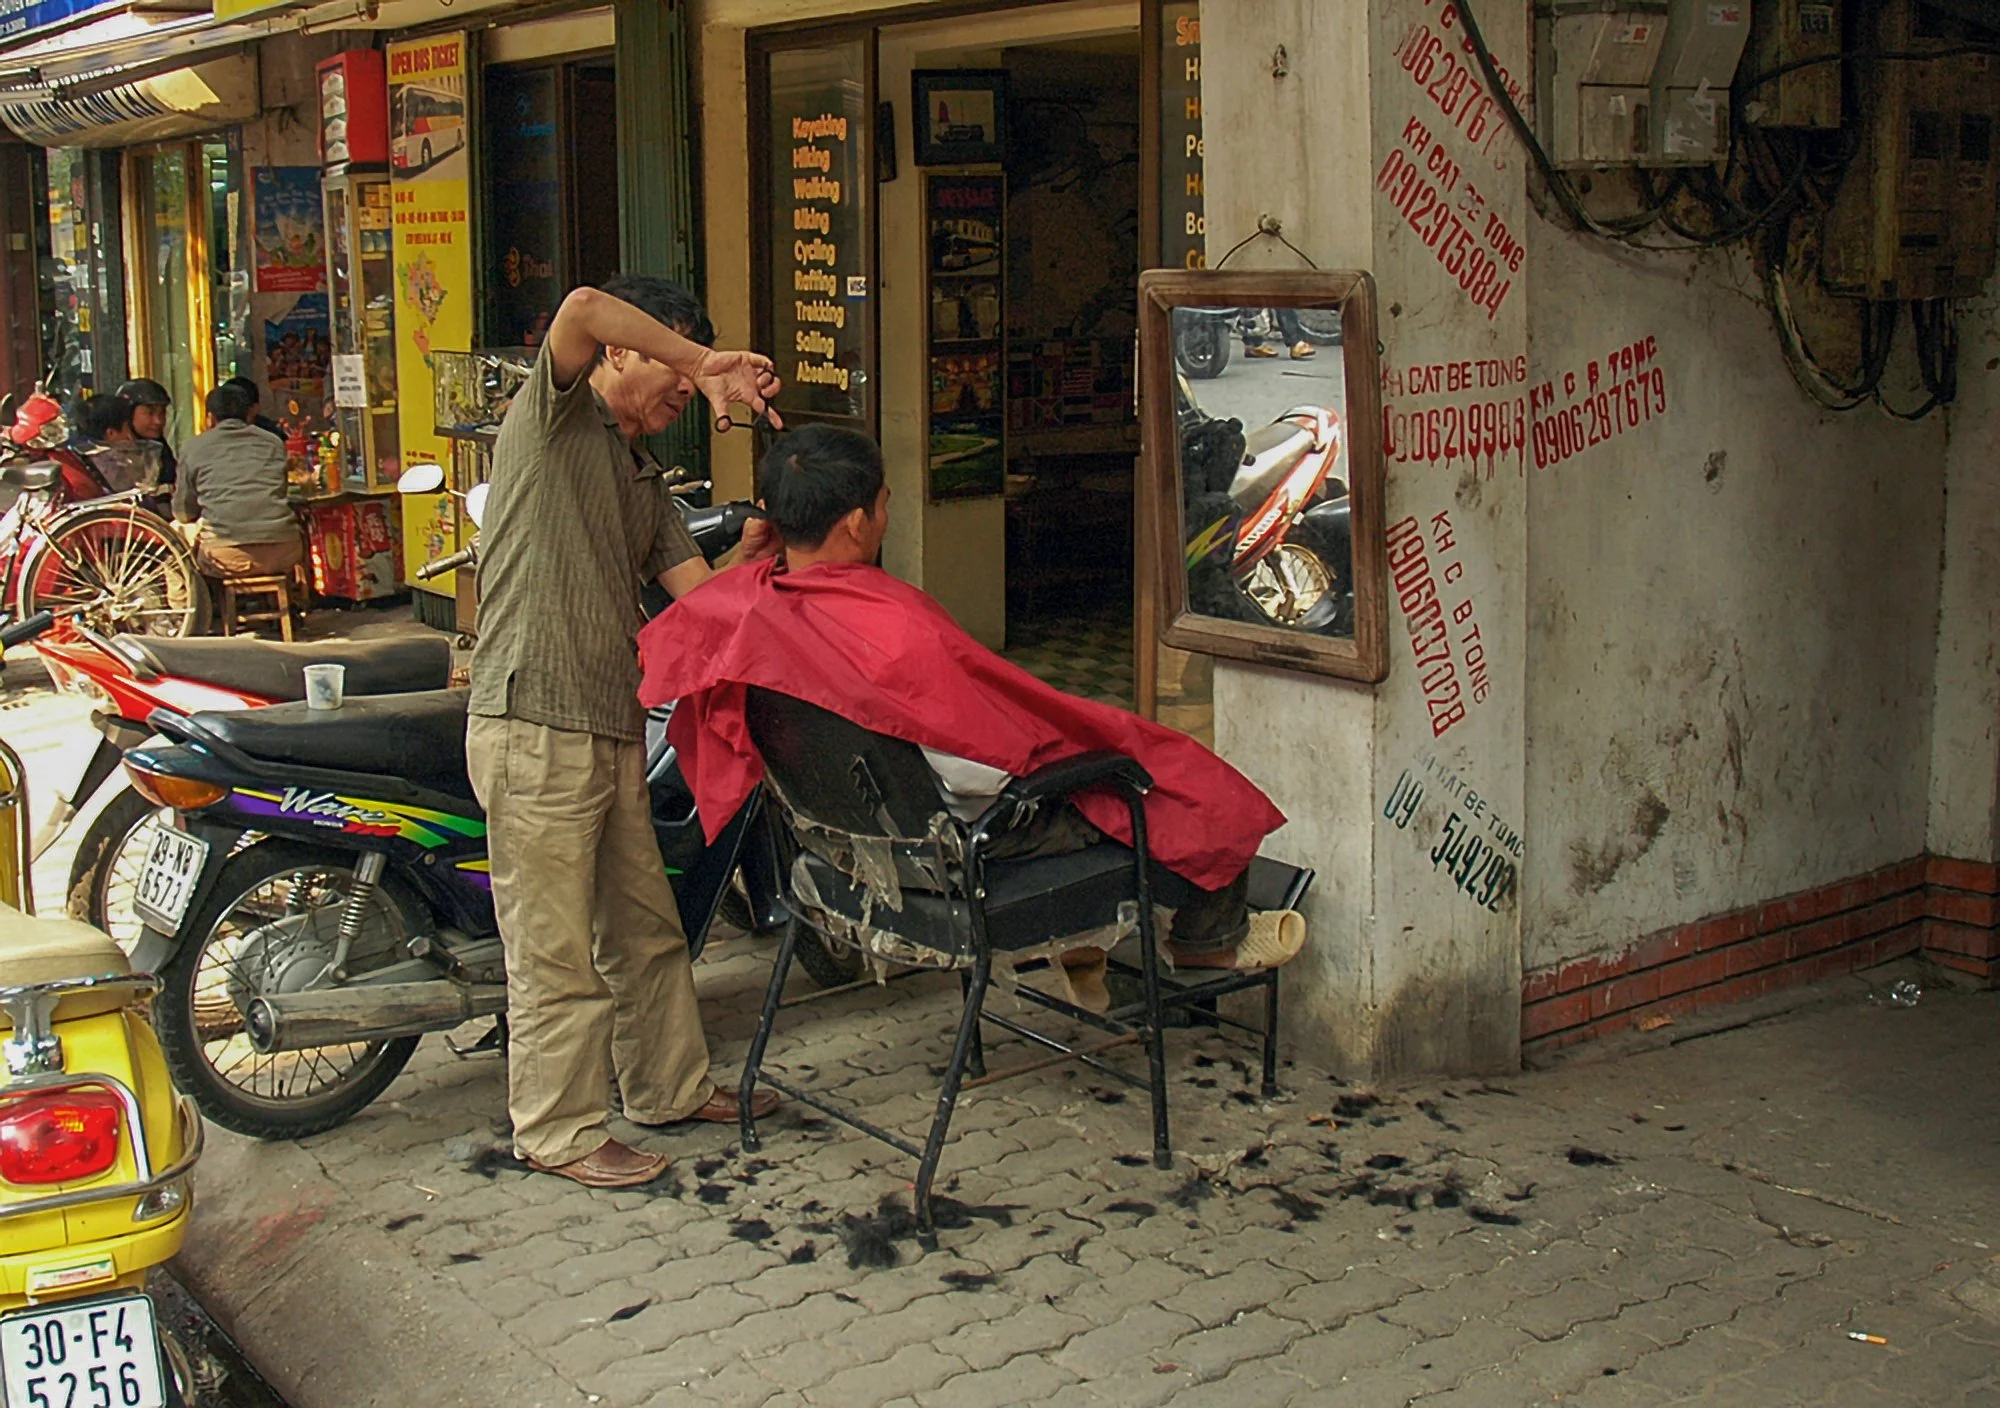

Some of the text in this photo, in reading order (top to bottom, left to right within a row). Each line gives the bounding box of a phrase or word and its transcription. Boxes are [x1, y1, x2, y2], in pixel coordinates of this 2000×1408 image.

[1408, 365, 1444, 395] CAT
[1447, 361, 1473, 392] BE
[1475, 355, 1527, 388] TONG
[1531, 366, 1667, 470] 0906287679
[1431, 510, 1456, 553] KH
[1443, 561, 1463, 584] C
[1453, 600, 1473, 624] B
[280, 786, 402, 823] Wave
[1463, 789, 1487, 820] BE
[21, 1306, 133, 1370] 30-F4
[27, 1361, 141, 1408] 5256
